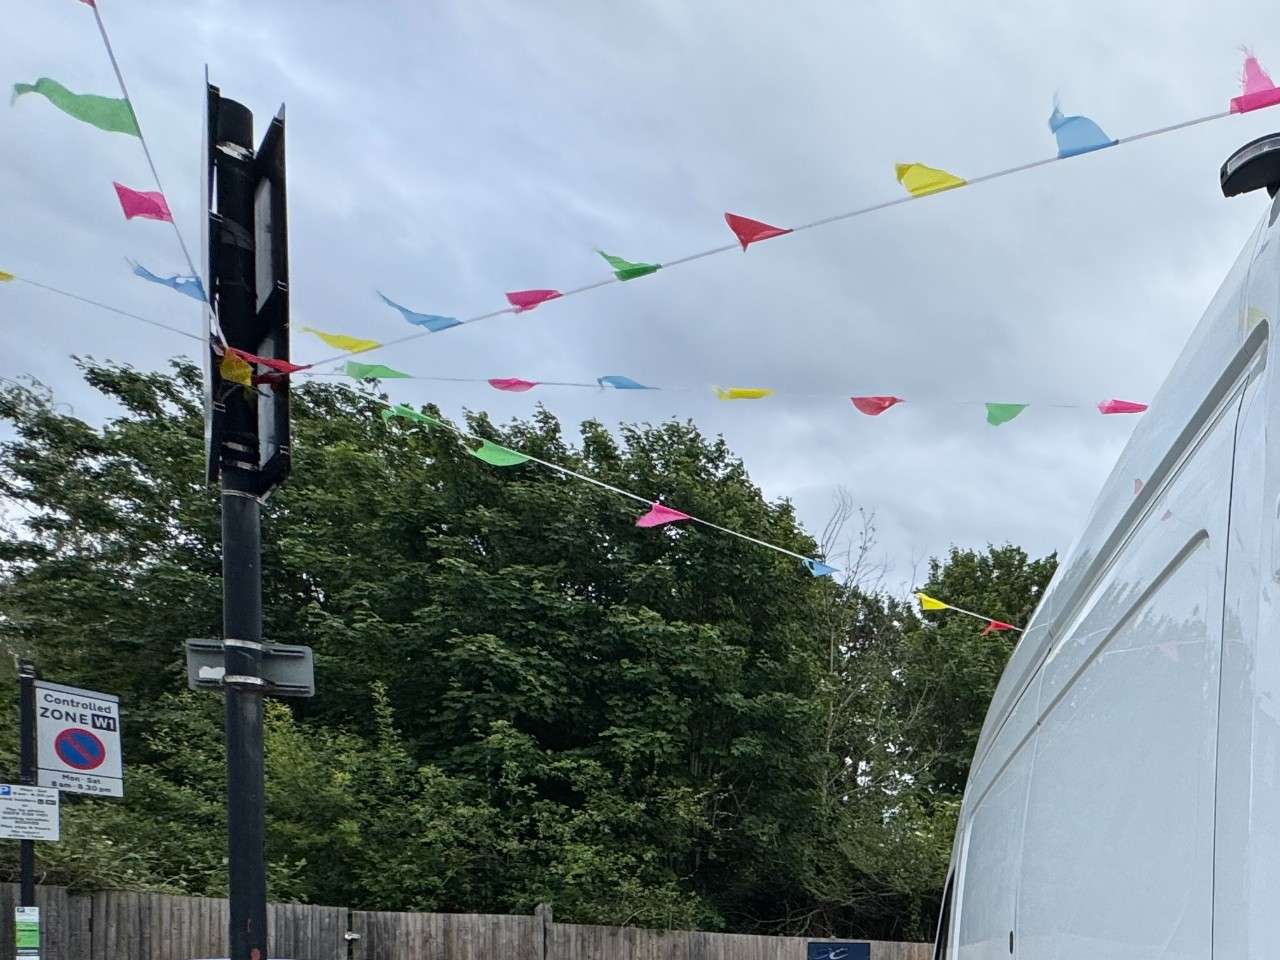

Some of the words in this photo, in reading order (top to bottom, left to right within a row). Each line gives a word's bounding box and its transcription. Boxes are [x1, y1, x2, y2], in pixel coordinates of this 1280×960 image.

[43, 693, 112, 714] Controlled
[40, 706, 89, 725] ZONE
[94, 715, 115, 730] W1
